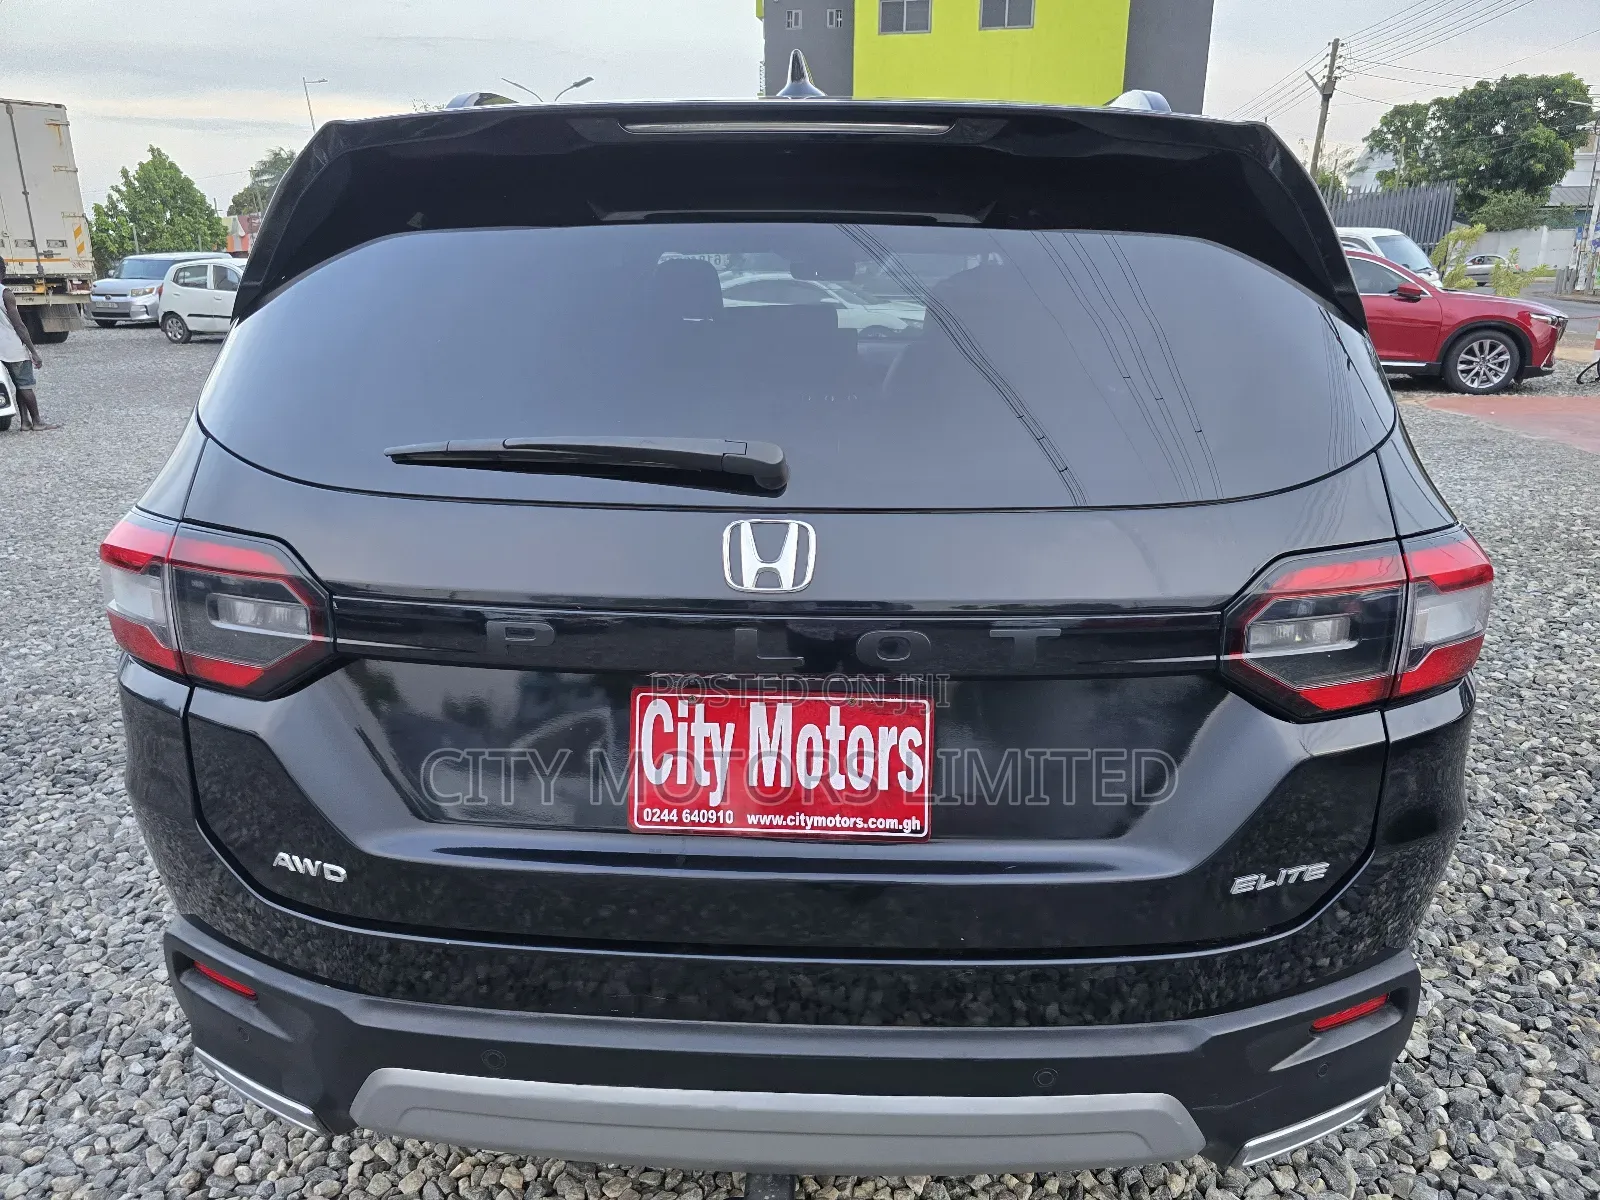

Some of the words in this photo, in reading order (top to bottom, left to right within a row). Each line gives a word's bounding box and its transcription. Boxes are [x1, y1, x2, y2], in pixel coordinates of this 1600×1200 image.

[641, 698, 736, 807] City
[749, 702, 924, 793] Motors
[643, 807, 678, 823] 0244
[681, 809, 734, 824] 640910
[747, 811, 921, 832] www.citymotors.com.gh
[273, 852, 347, 882] AWD
[1230, 861, 1330, 894] ELITE
